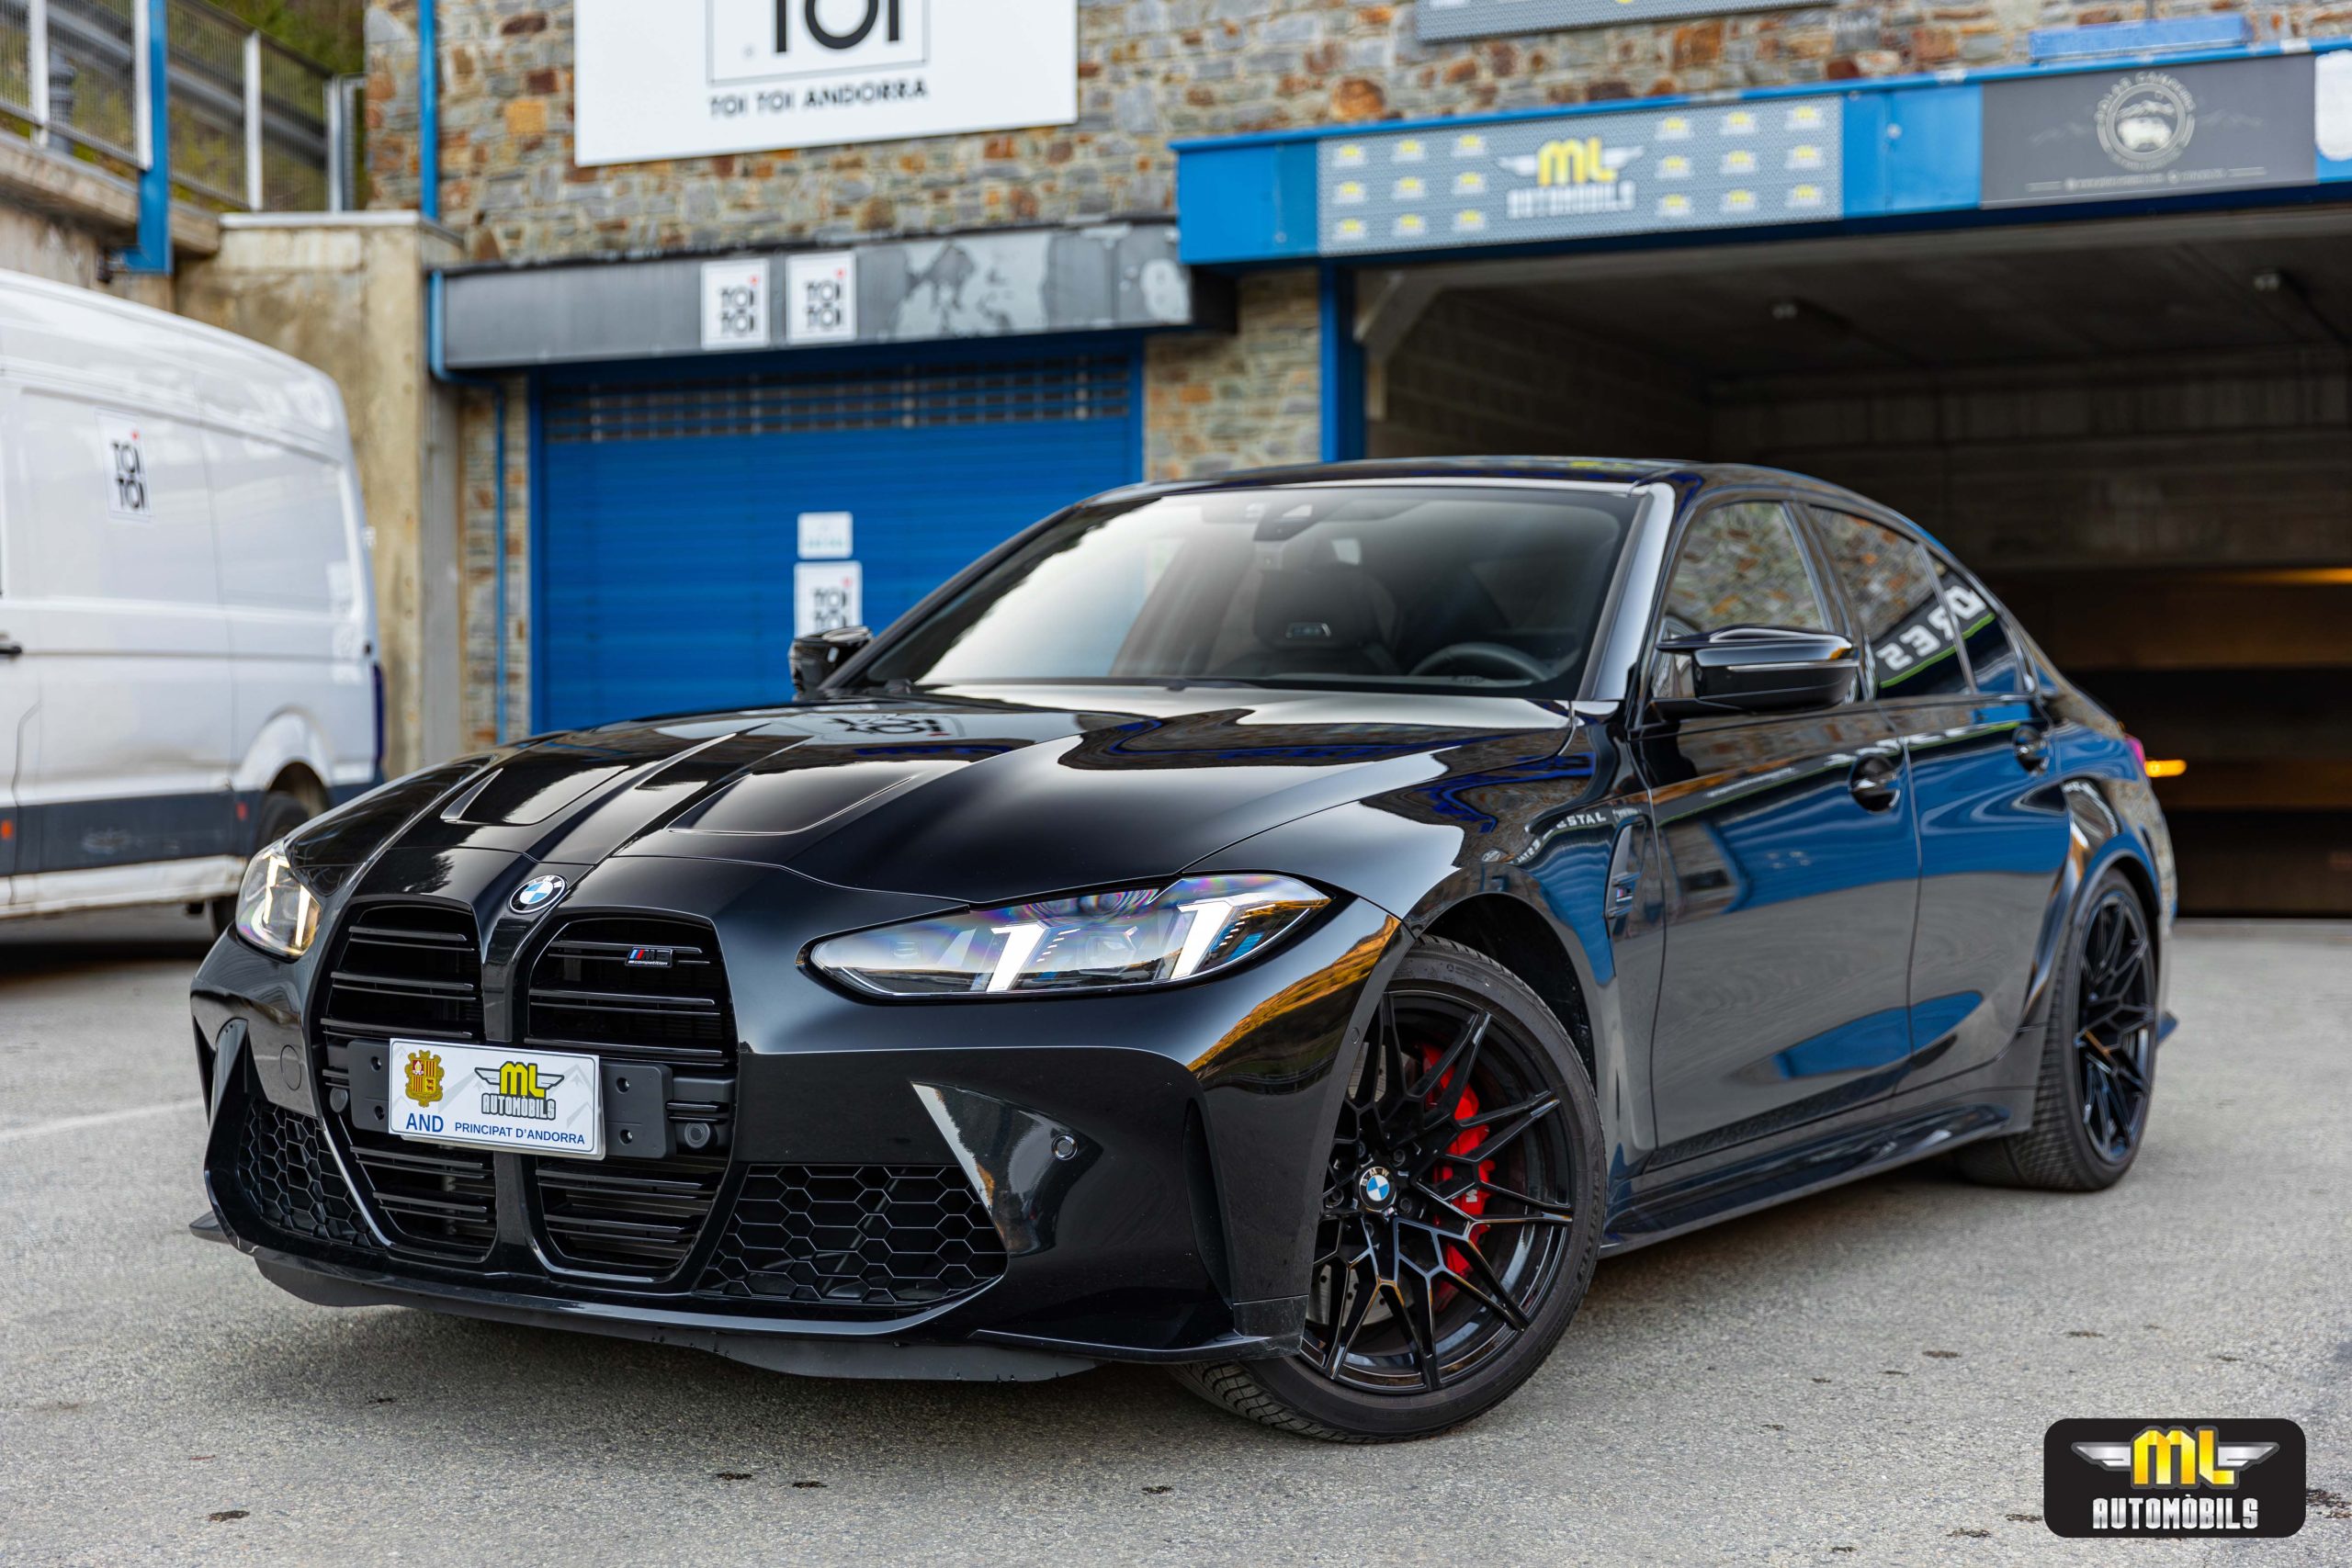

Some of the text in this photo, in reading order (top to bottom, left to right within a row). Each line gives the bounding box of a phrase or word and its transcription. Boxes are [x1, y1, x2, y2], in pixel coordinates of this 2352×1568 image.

[710, 79, 928, 116] TOI TOI ANDORRA
[1537, 135, 1618, 187] ML
[500, 1061, 547, 1099] ML
[405, 1112, 585, 1145] AND PRINCIPAT D'ANDORRA
[1360, 1168, 1389, 1186] BMW
